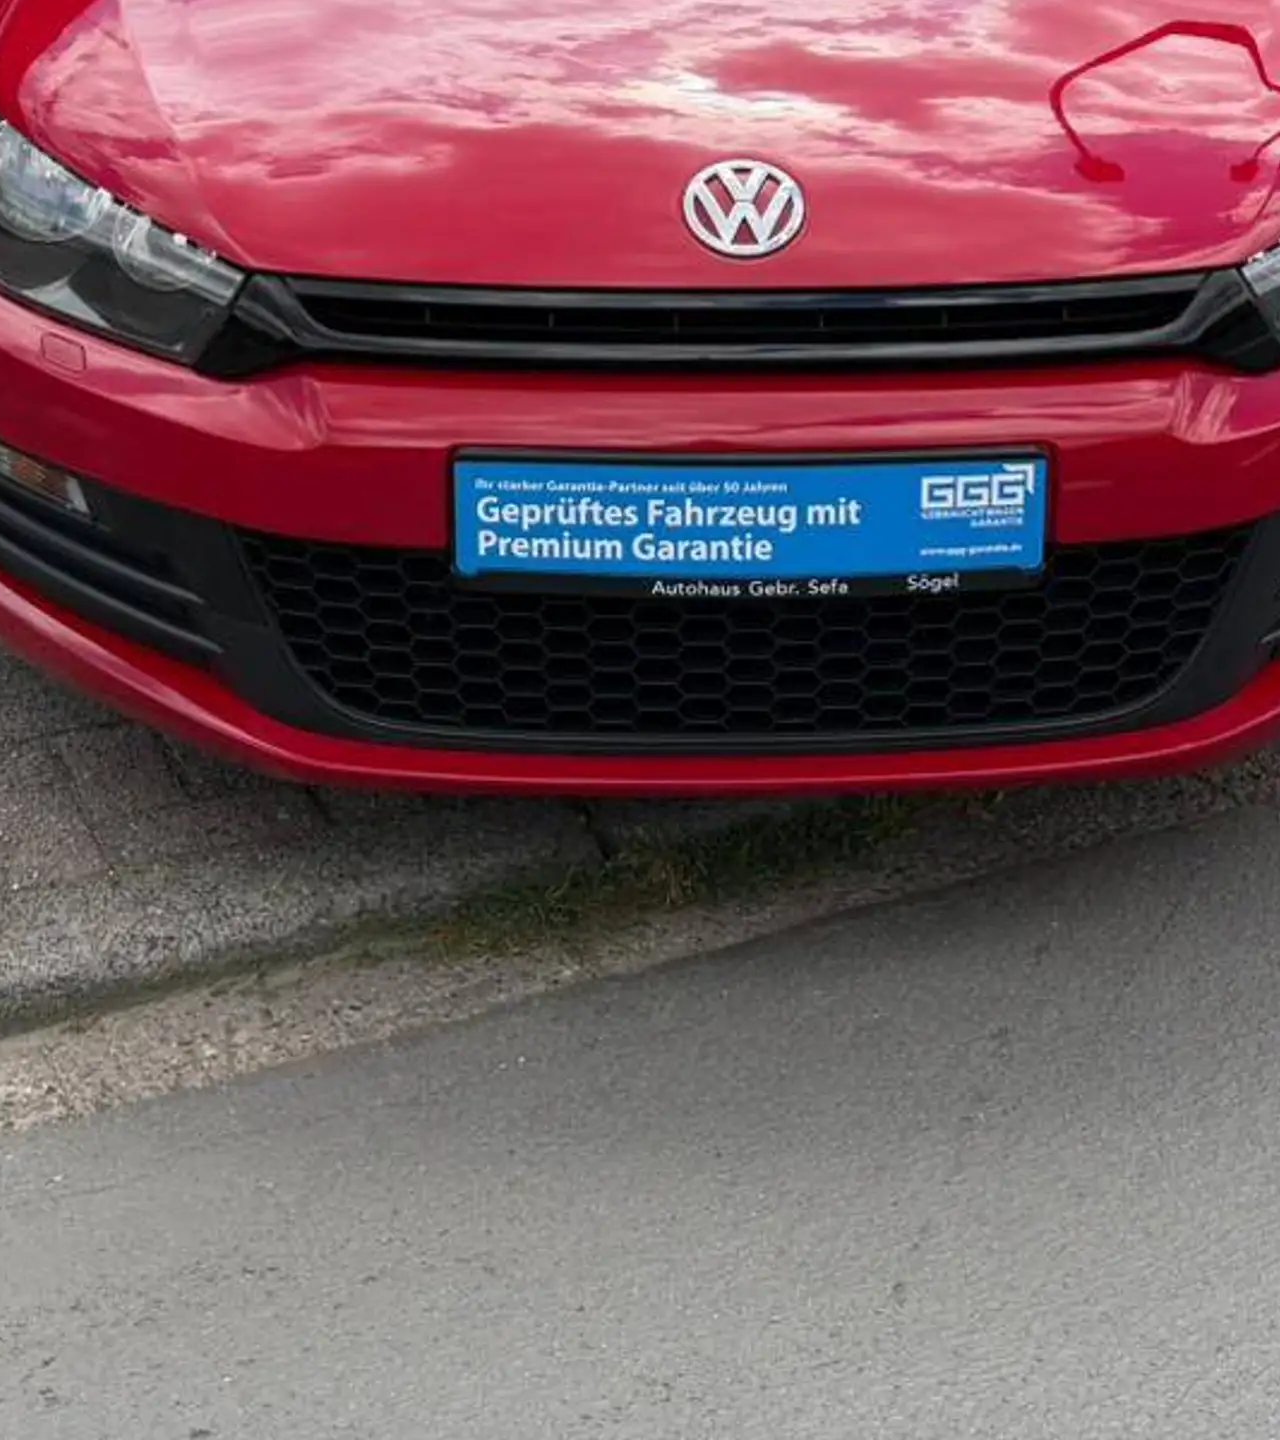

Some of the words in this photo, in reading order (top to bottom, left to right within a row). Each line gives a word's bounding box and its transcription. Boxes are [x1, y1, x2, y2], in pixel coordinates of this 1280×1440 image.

[685, 160, 804, 254] VW
[921, 471, 1027, 508] GGG
[476, 496, 639, 531] Geprüftes
[647, 498, 798, 534] Fahrzeug
[806, 497, 862, 526] mit
[477, 530, 623, 559] Premium
[632, 532, 774, 561] Garantie
[651, 580, 742, 598] Autohaus
[748, 580, 801, 598] Gebr.
[807, 579, 849, 596] Sefa
[906, 572, 960, 594] Sögel
